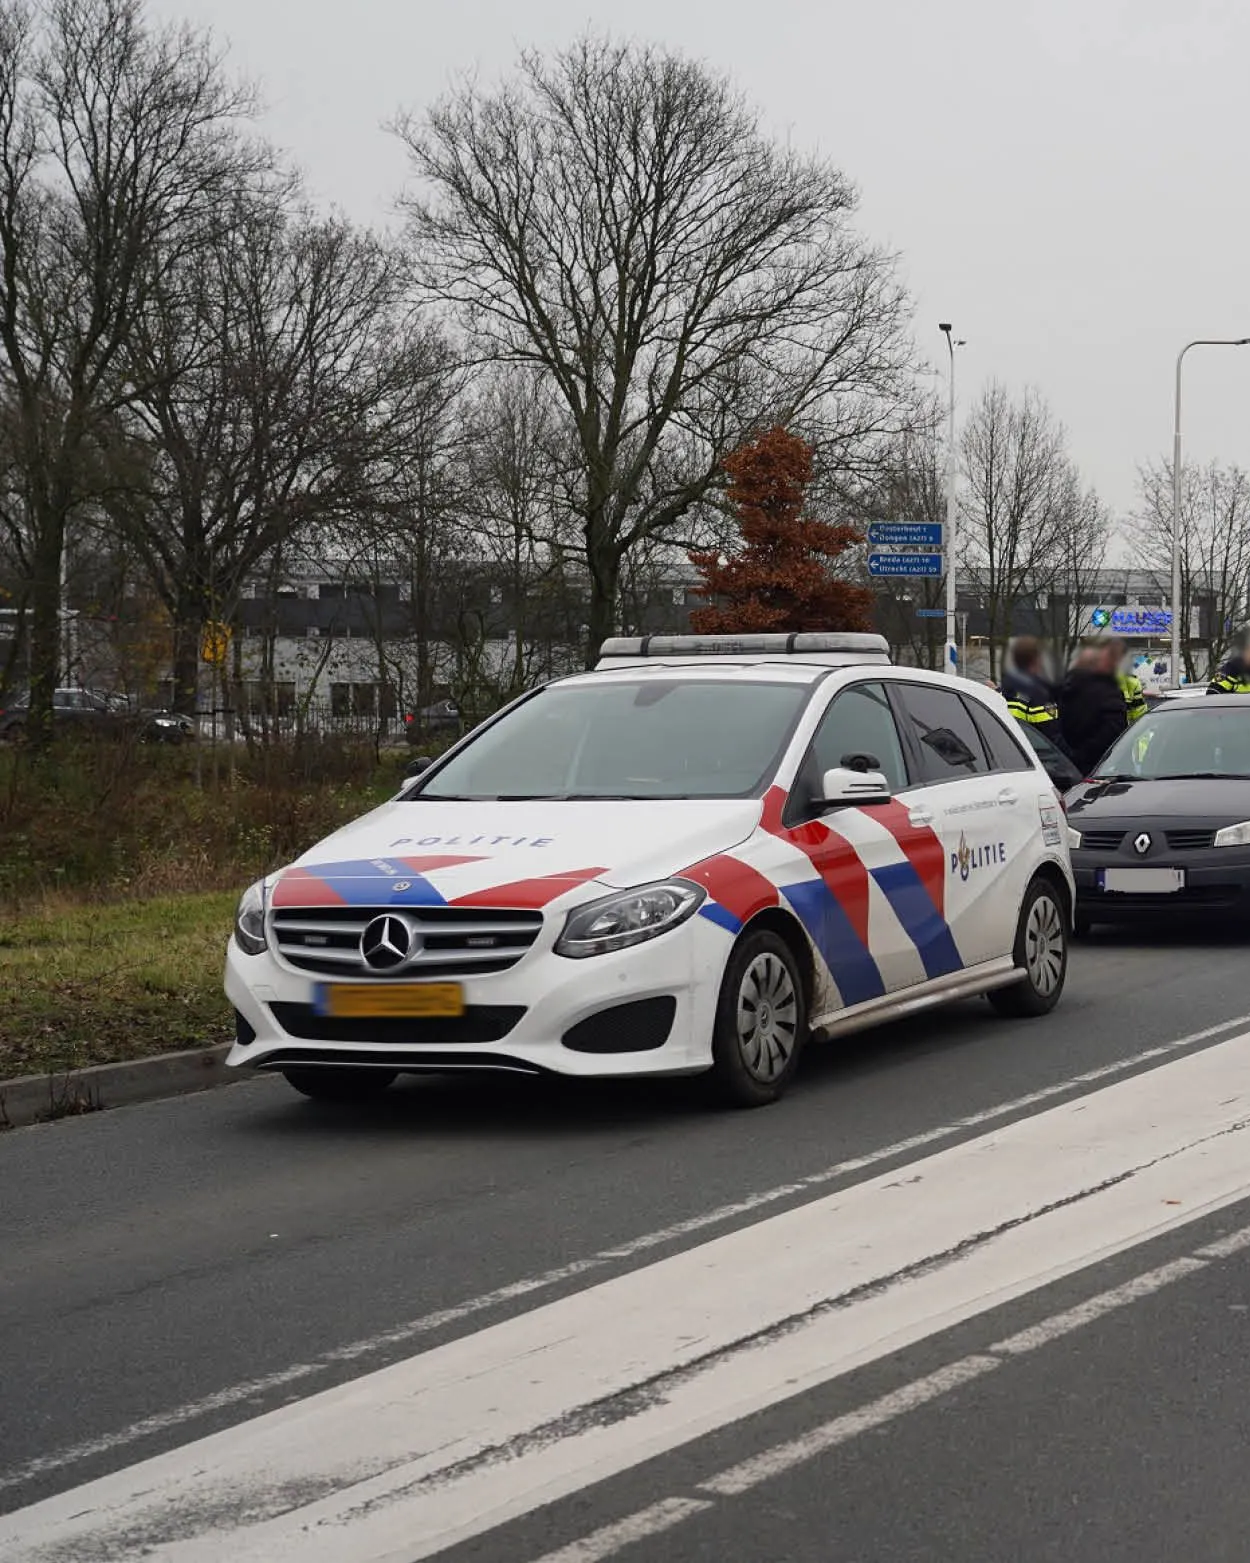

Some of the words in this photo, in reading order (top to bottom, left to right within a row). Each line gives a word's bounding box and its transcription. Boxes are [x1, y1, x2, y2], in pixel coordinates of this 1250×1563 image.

[880, 535, 907, 543] Dongen
[880, 565, 907, 573] Utrecht
[389, 835, 555, 848] POLITIE
[951, 842, 1006, 882] POLITIE
